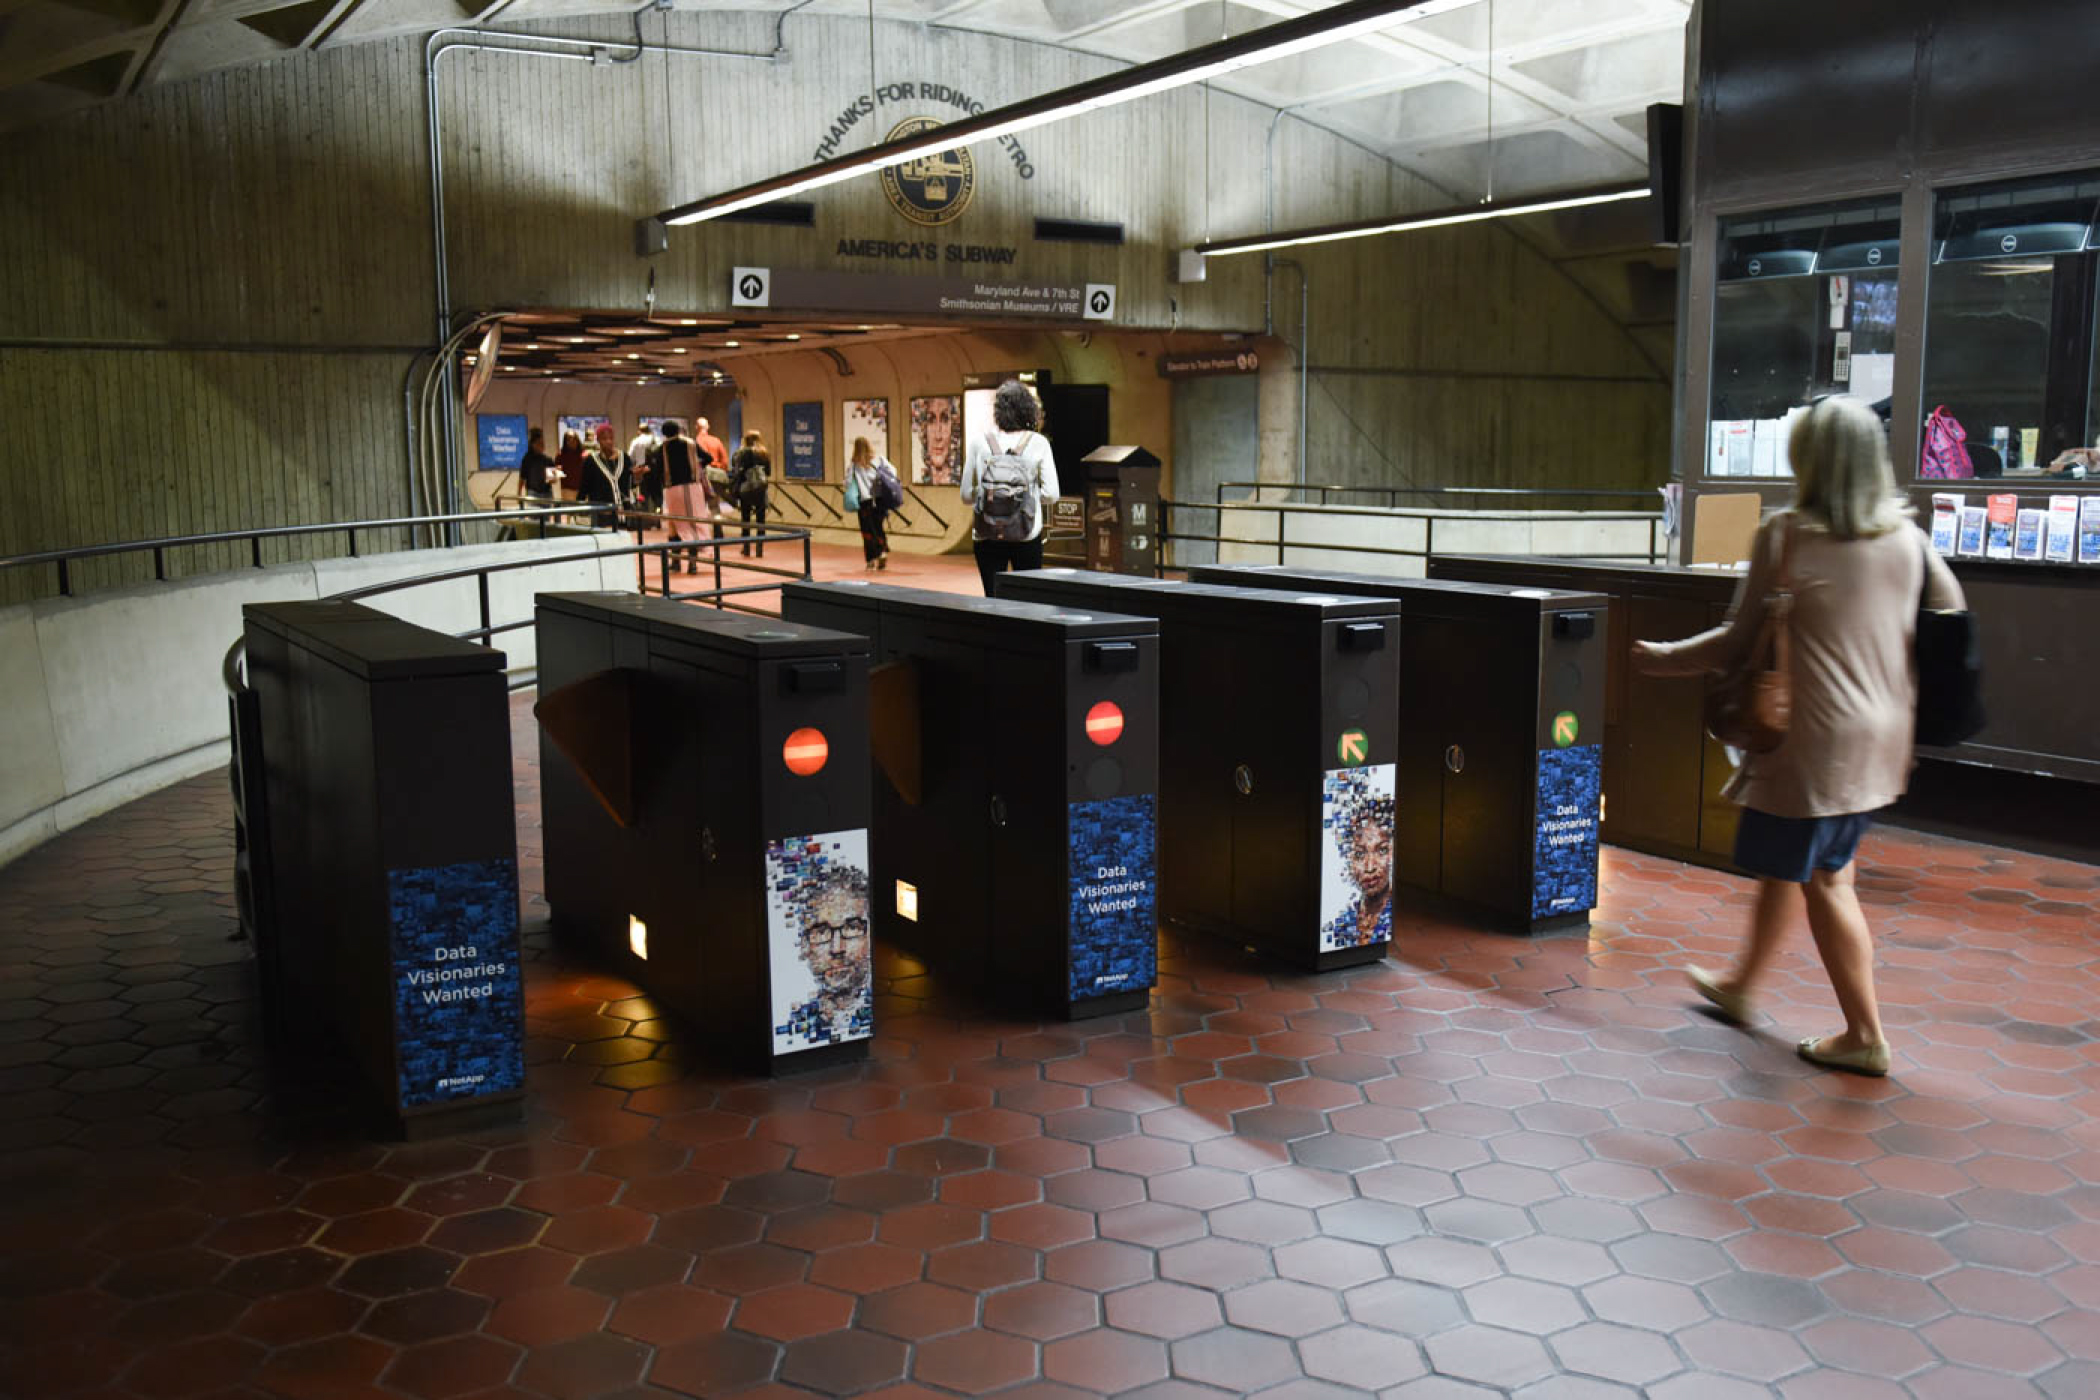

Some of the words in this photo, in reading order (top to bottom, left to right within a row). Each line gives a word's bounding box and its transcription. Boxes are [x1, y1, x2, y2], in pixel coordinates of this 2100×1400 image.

[814, 96, 874, 162] THANKS
[876, 82, 915, 106] FOR
[920, 82, 984, 116] RIDING
[837, 240, 938, 260] AMERICA'S
[944, 244, 1017, 264] SUBWAY
[974, 284, 1020, 298] Maryland
[1022, 287, 1040, 297] Ave
[1042, 288, 1050, 298] &
[1052, 288, 1067, 298] 7th
[1069, 288, 1080, 300] St
[940, 297, 1000, 310] Smithsonian
[1003, 300, 1050, 312] Museums
[1058, 302, 1080, 312] VRE
[1557, 805, 1578, 816] Data
[1542, 817, 1591, 832] Visionaries
[1549, 832, 1584, 846] Wanted
[1098, 864, 1127, 879] Data
[1079, 880, 1146, 898] Visionaries
[1088, 896, 1136, 914] Wanted
[434, 944, 477, 961] Data
[407, 962, 505, 985] Visionaries
[423, 982, 492, 1004] Wanted
